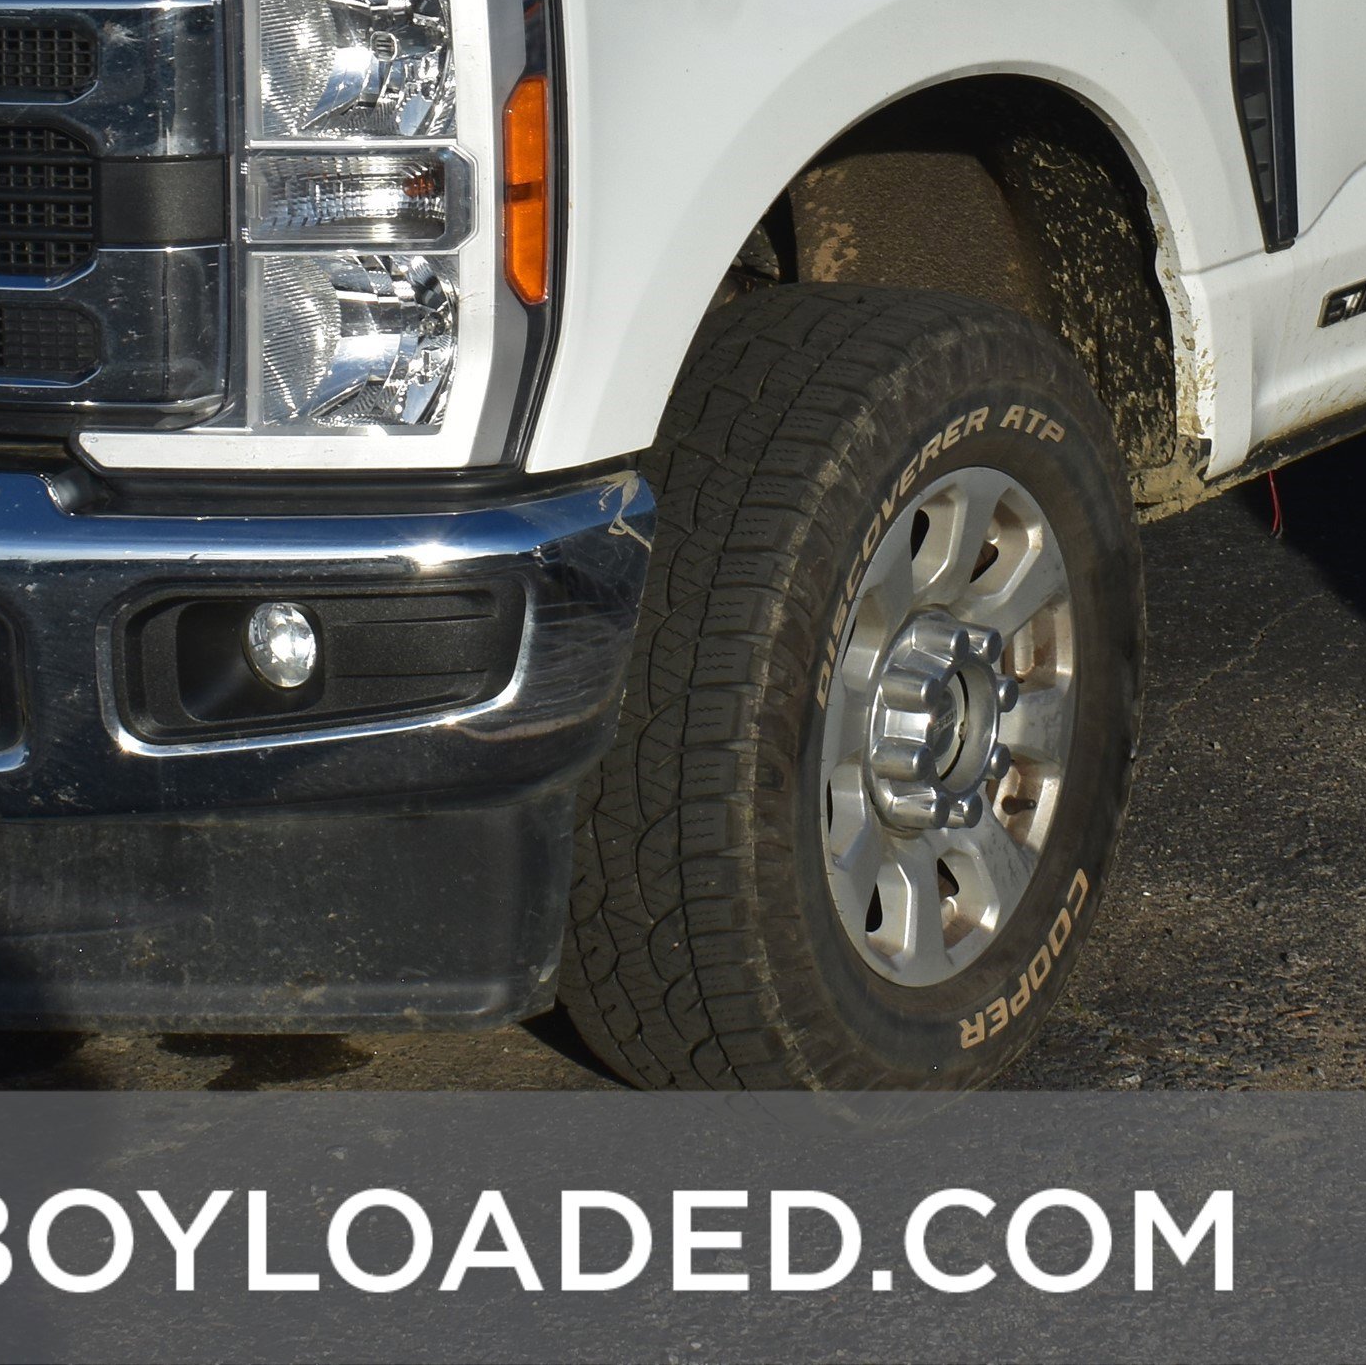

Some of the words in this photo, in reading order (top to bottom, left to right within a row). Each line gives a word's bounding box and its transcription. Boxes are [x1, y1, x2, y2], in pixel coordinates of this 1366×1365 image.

[817, 406, 989, 710] DISCOVERER
[1000, 404, 1065, 443] ATP
[958, 867, 1089, 1050] COOPER
